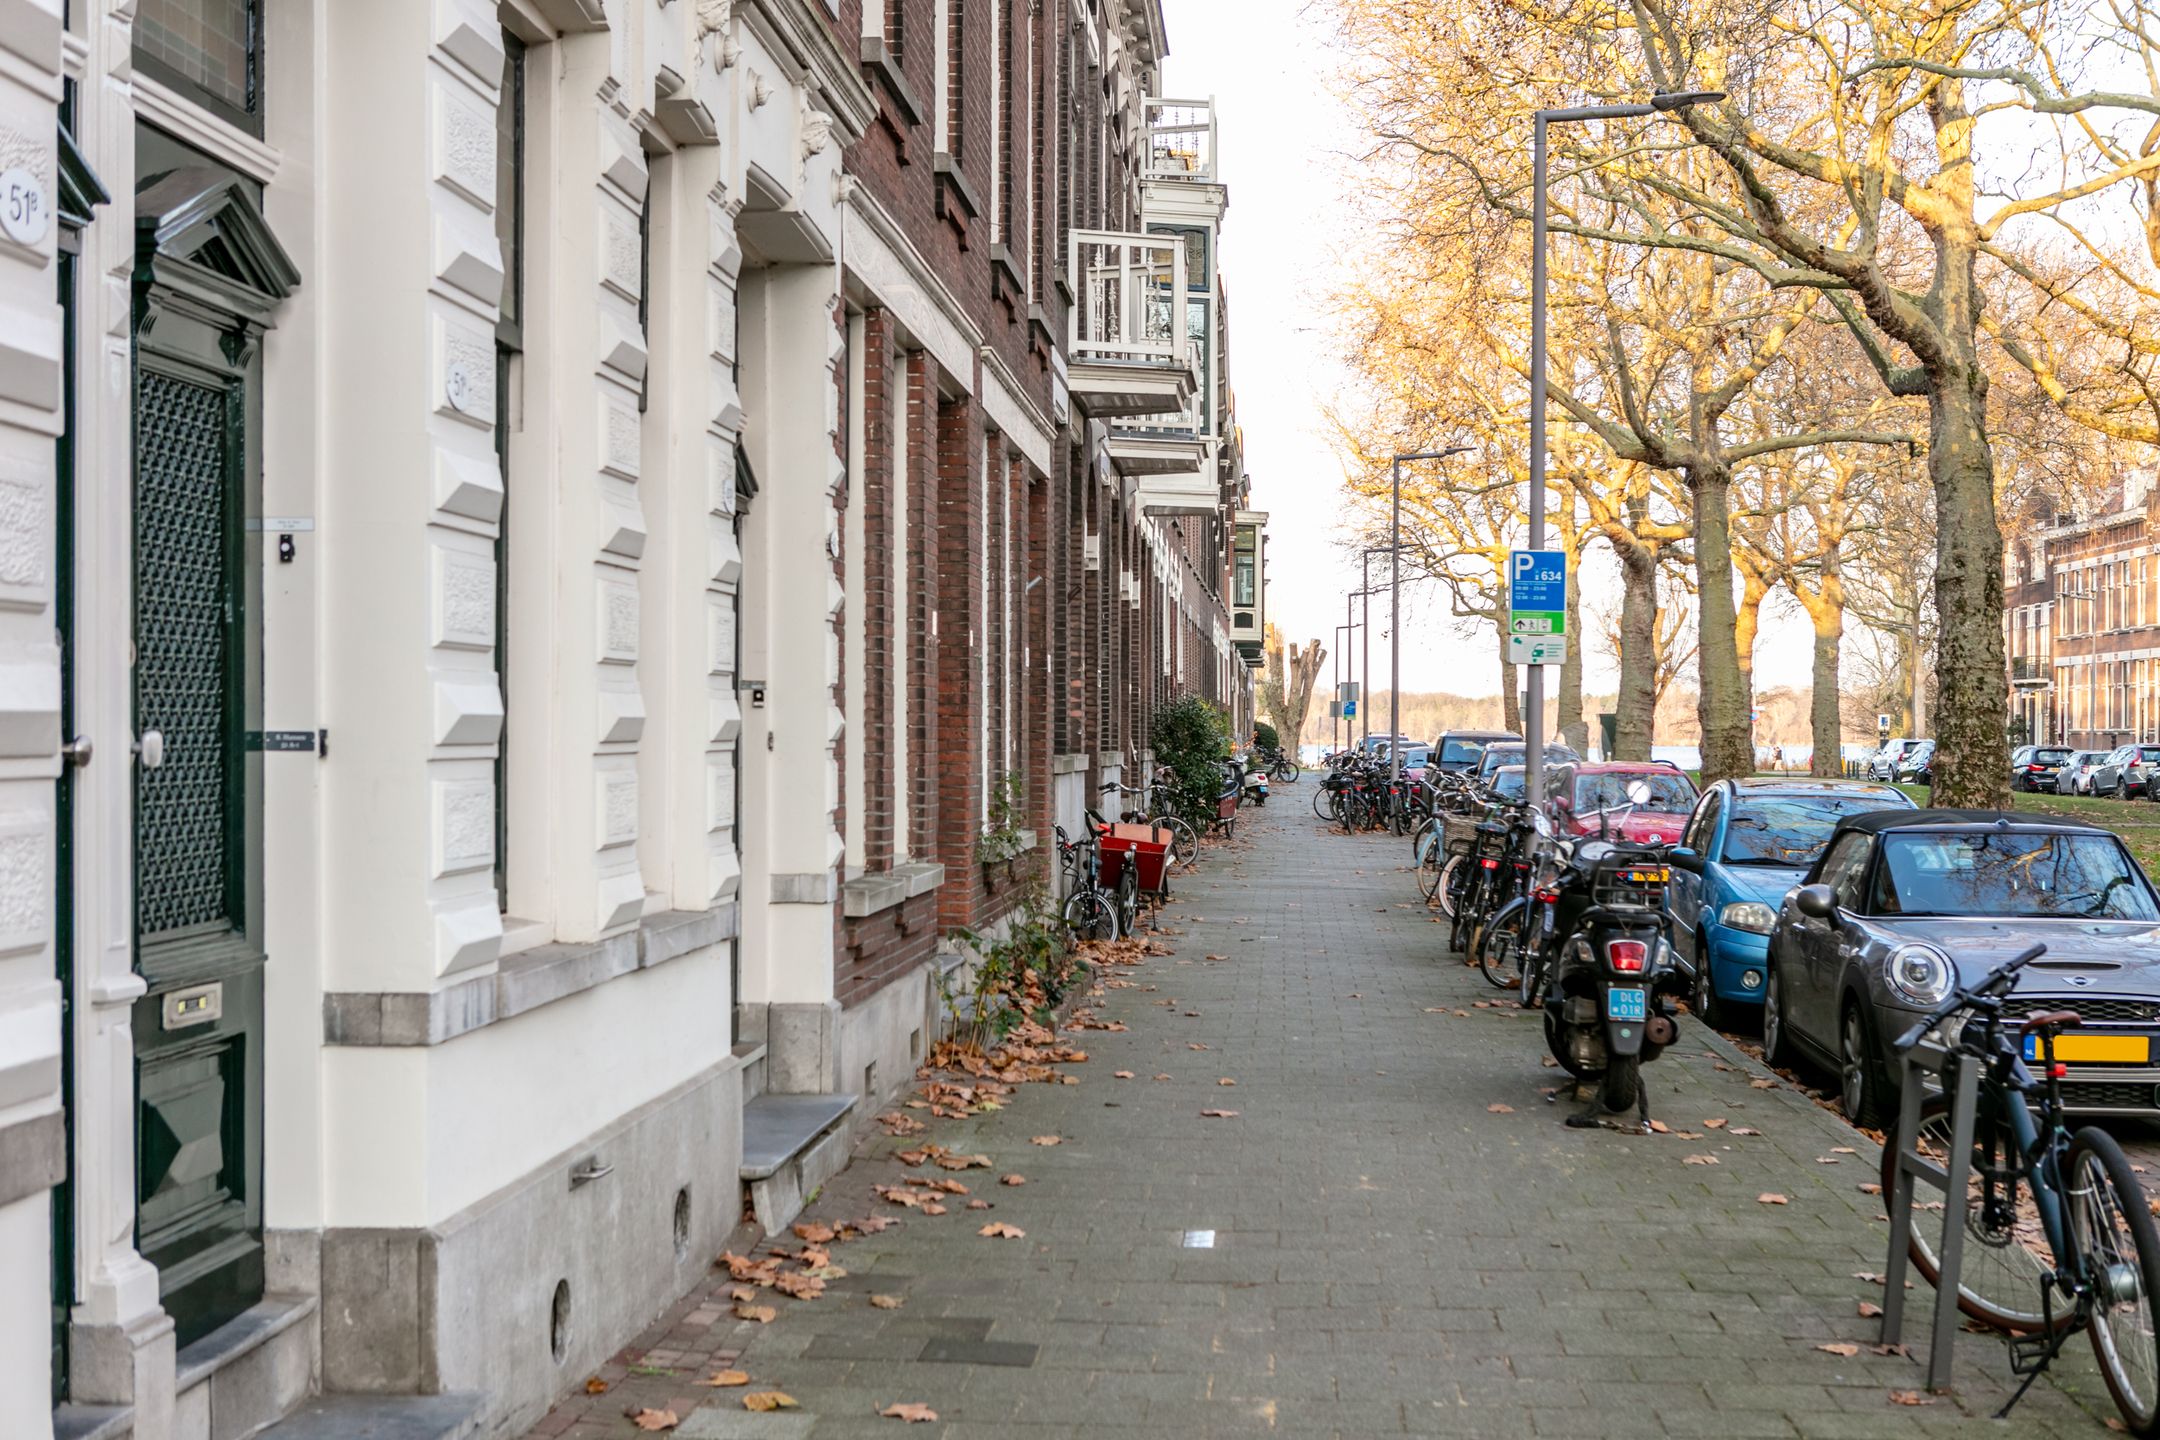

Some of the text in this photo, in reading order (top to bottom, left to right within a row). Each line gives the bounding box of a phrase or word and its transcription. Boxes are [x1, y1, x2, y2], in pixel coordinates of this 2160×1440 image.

[1515, 553, 1535, 580] P
[1541, 571, 1562, 581] 634
[2025, 1048, 2035, 1056] NL
